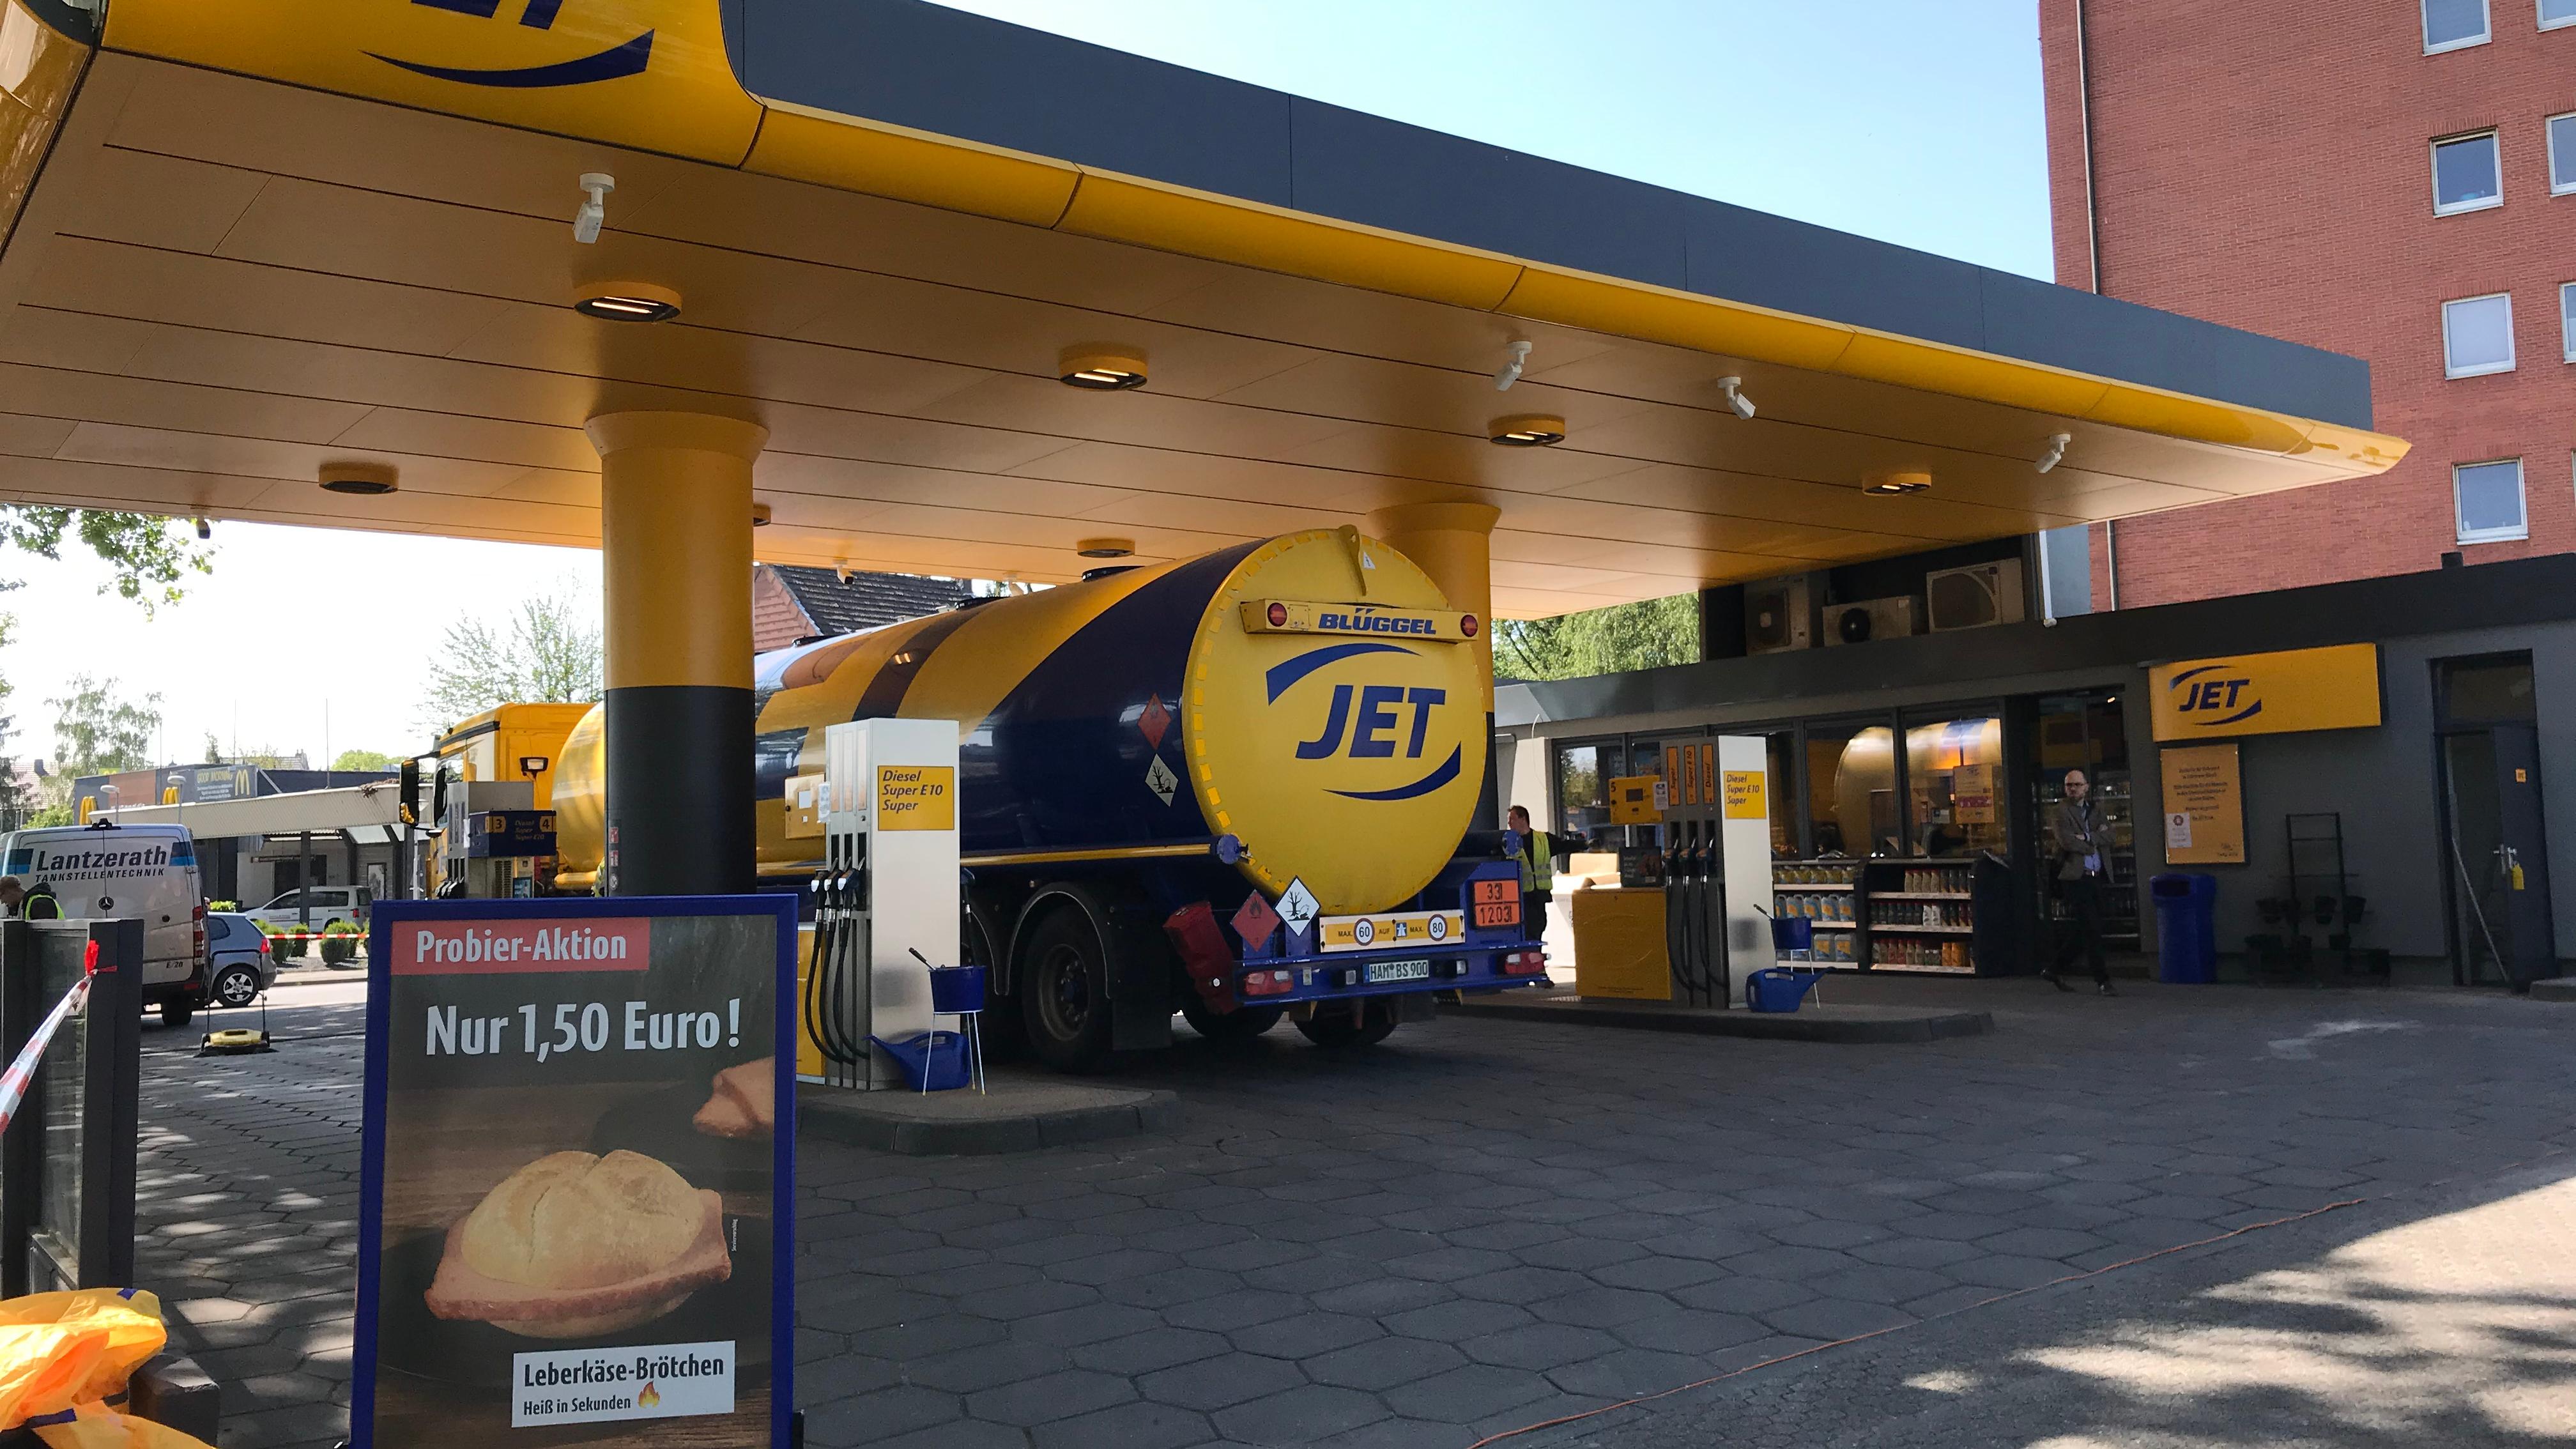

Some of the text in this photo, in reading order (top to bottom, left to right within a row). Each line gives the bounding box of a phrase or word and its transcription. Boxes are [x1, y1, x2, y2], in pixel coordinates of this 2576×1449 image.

[1319, 608, 1436, 634] BLÜGGEL
[2179, 678, 2250, 712] JET
[1295, 685, 1446, 759] JET
[883, 770, 921, 781] Diesel
[1727, 774, 1747, 783] Diesel
[882, 784, 918, 799] Super
[1611, 781, 1616, 793] 5
[1727, 785, 1746, 794] Super
[882, 799, 919, 814] Super
[1728, 795, 1747, 807] Super
[495, 819, 502, 829] 3
[542, 819, 549, 829] 4
[36, 845, 167, 871] Lantzerath
[36, 868, 164, 882] TANKSTELLENTECHNIK
[1359, 926, 1370, 938] 60
[1432, 923, 1443, 933] 80
[417, 927, 626, 963] Probier-Aktion
[1370, 962, 1428, 980] HAM BS 900
[426, 998, 740, 1063] Nur 1,50 Euro!
[525, 1353, 724, 1387] Leberkäse-Brötchen
[524, 1395, 631, 1415] Heiß in Sekunden
